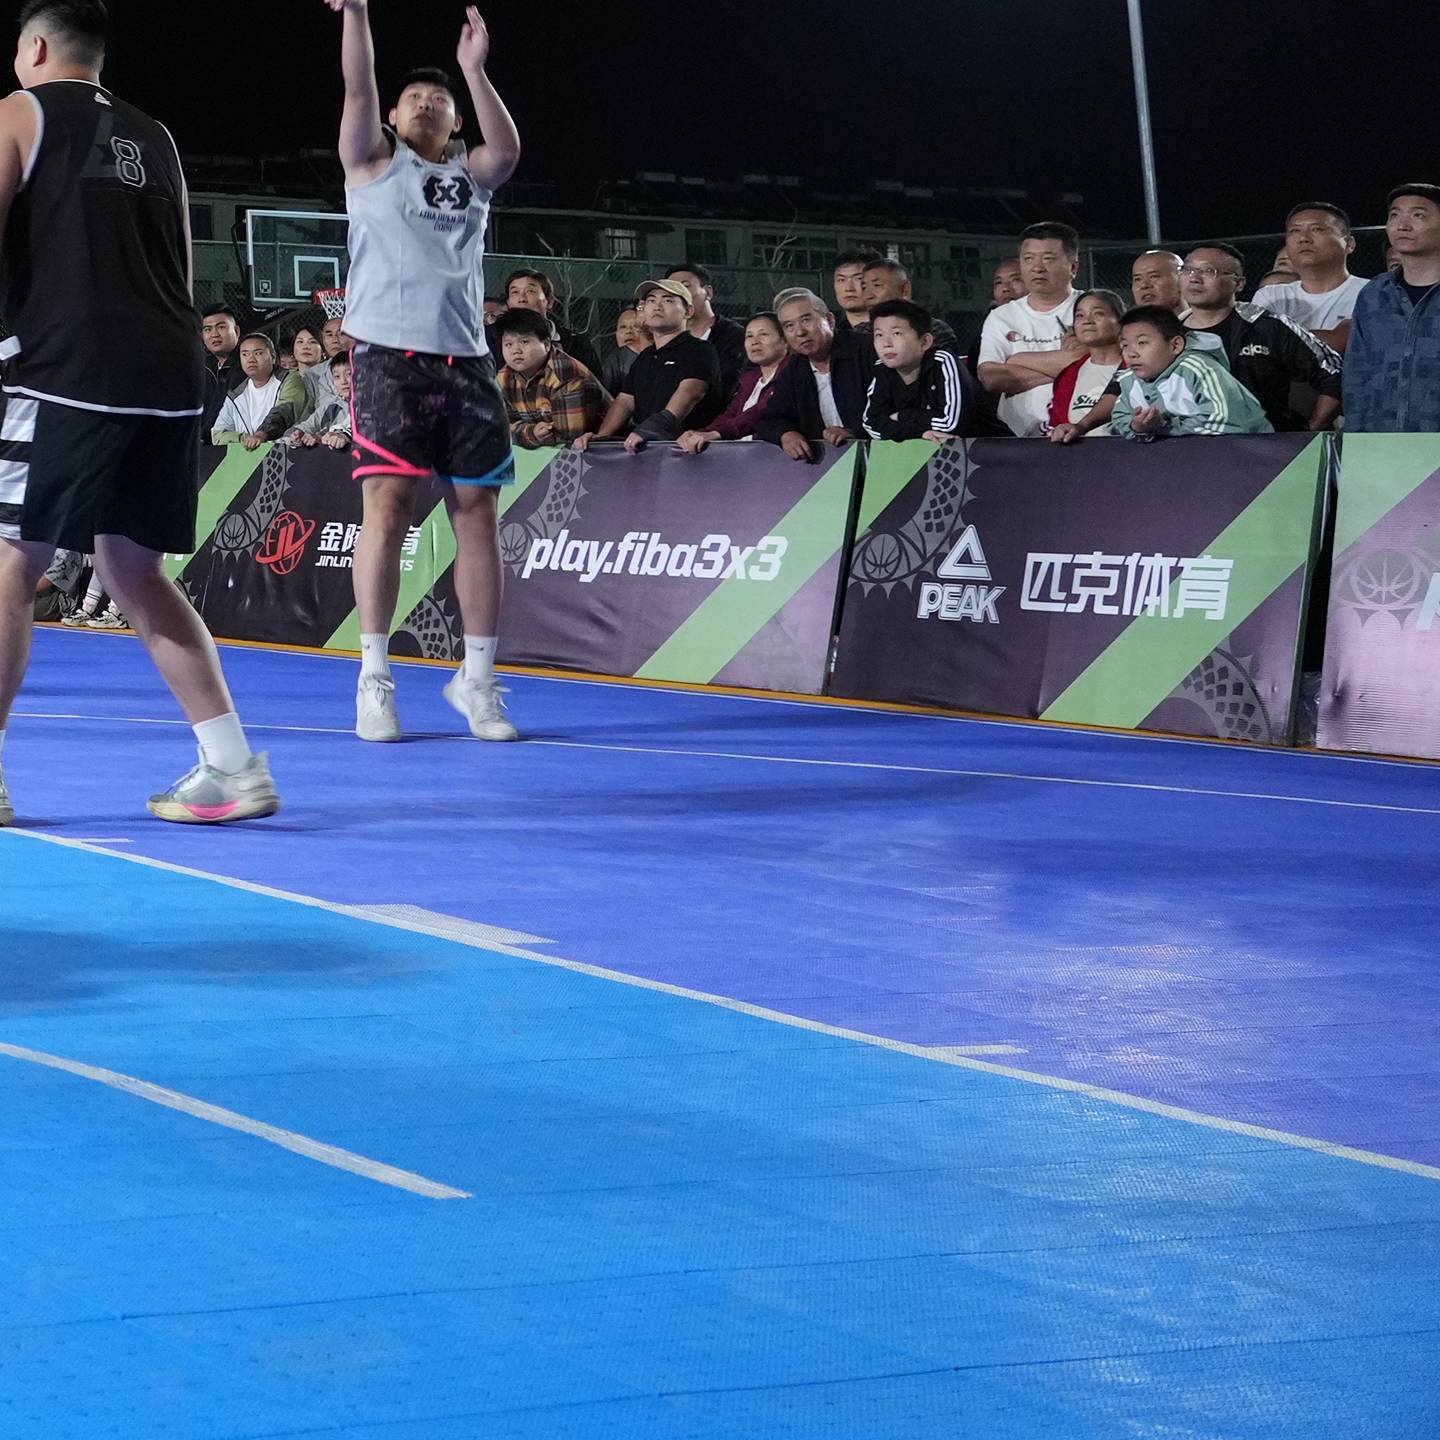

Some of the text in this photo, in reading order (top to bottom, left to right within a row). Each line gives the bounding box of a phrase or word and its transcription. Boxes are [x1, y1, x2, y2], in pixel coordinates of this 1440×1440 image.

[110, 136, 146, 188] 8
[521, 529, 789, 583] play.fiba3x3
[917, 582, 1007, 624] PEAK
[1020, 551, 1234, 621] 匹克体育
